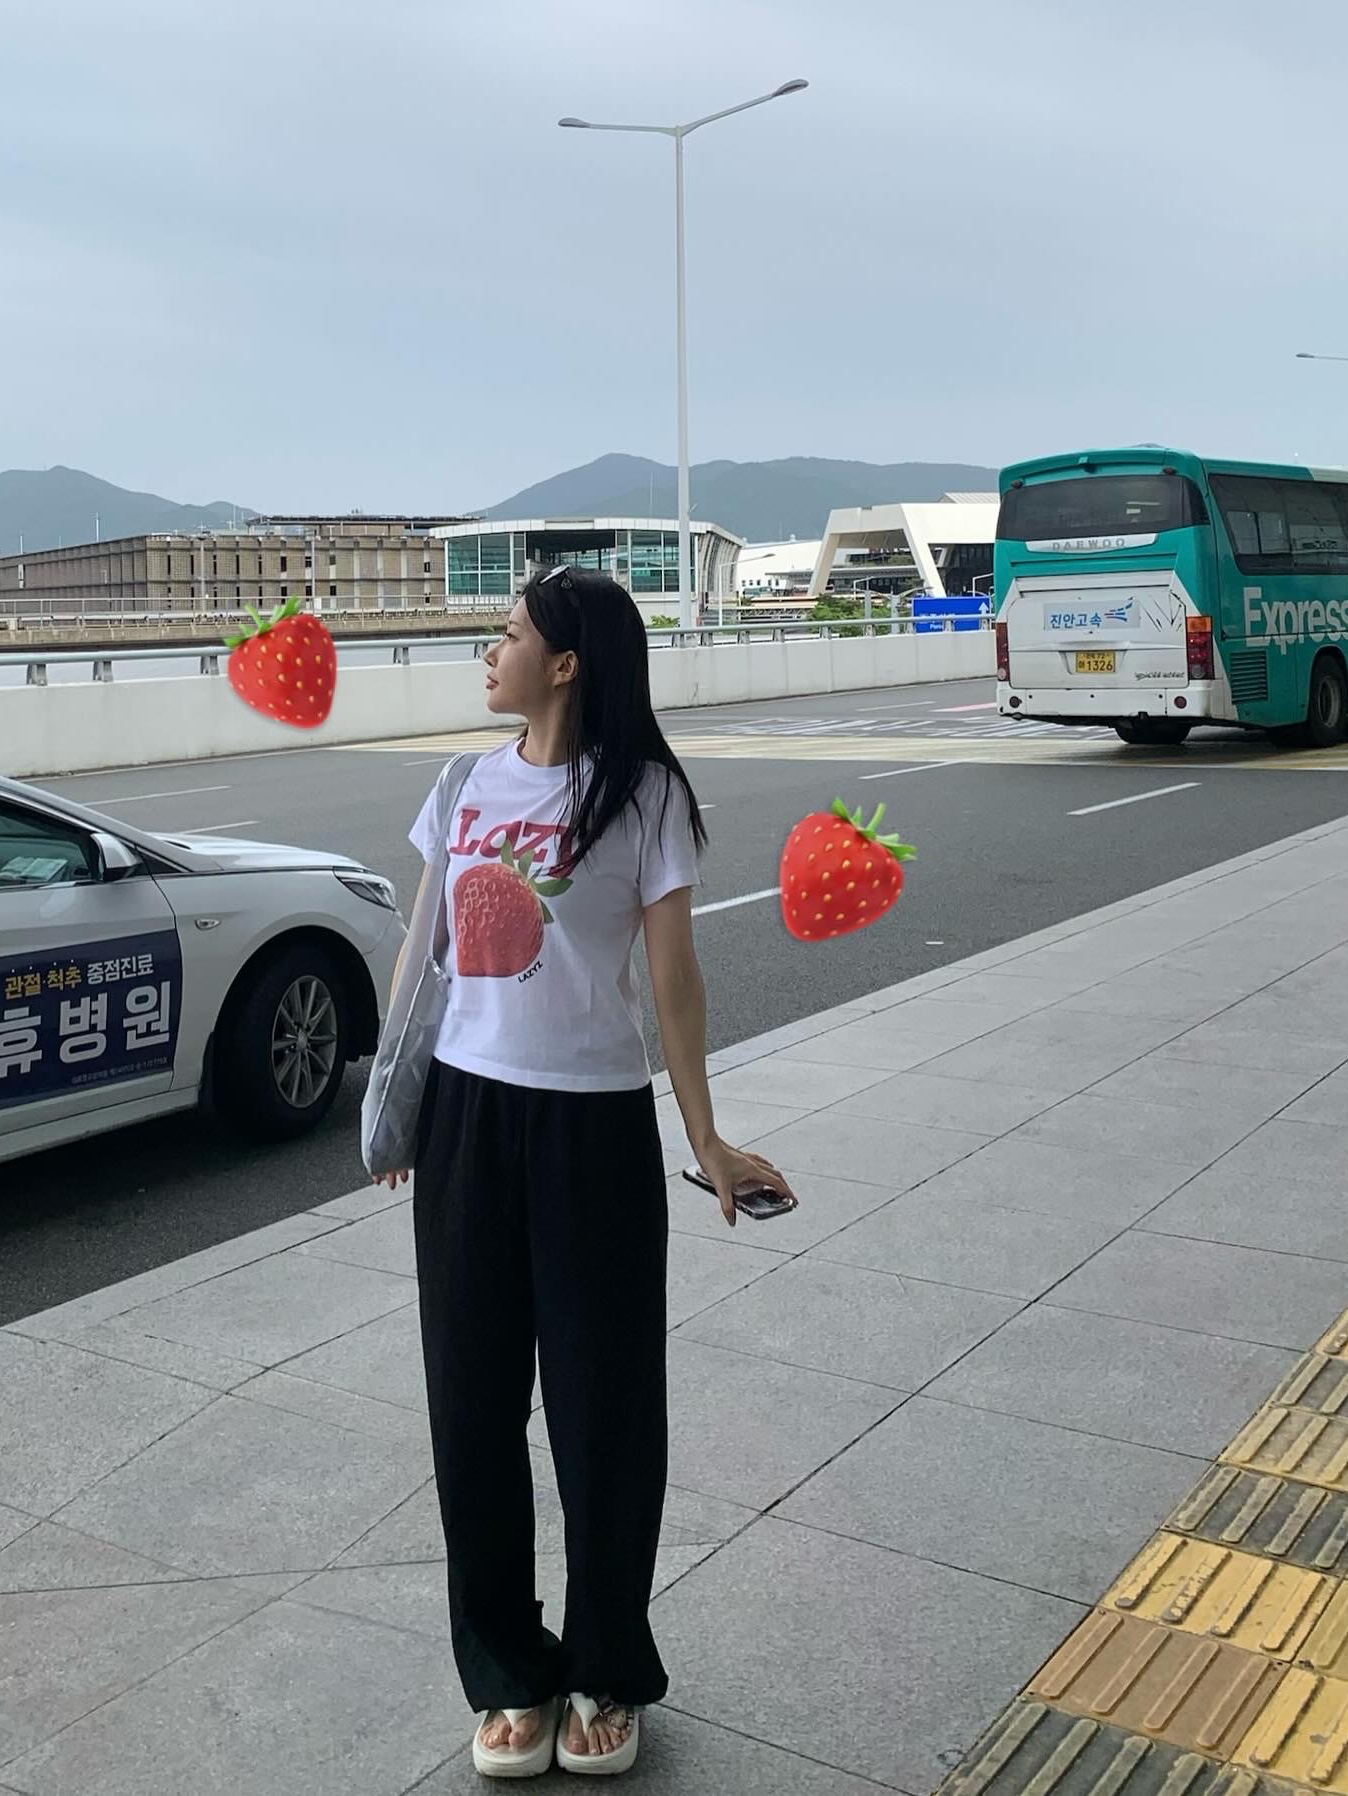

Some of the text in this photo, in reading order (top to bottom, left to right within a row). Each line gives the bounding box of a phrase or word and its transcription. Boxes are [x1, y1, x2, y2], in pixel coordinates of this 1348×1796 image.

[1052, 538, 1125, 550] DAEWOO
[1050, 612, 1102, 629] 진안고속
[1243, 587, 1348, 655] Express
[1087, 660, 1113, 671] 1326
[87, 953, 154, 985] 중점진료
[518, 960, 543, 982] LAZYZ
